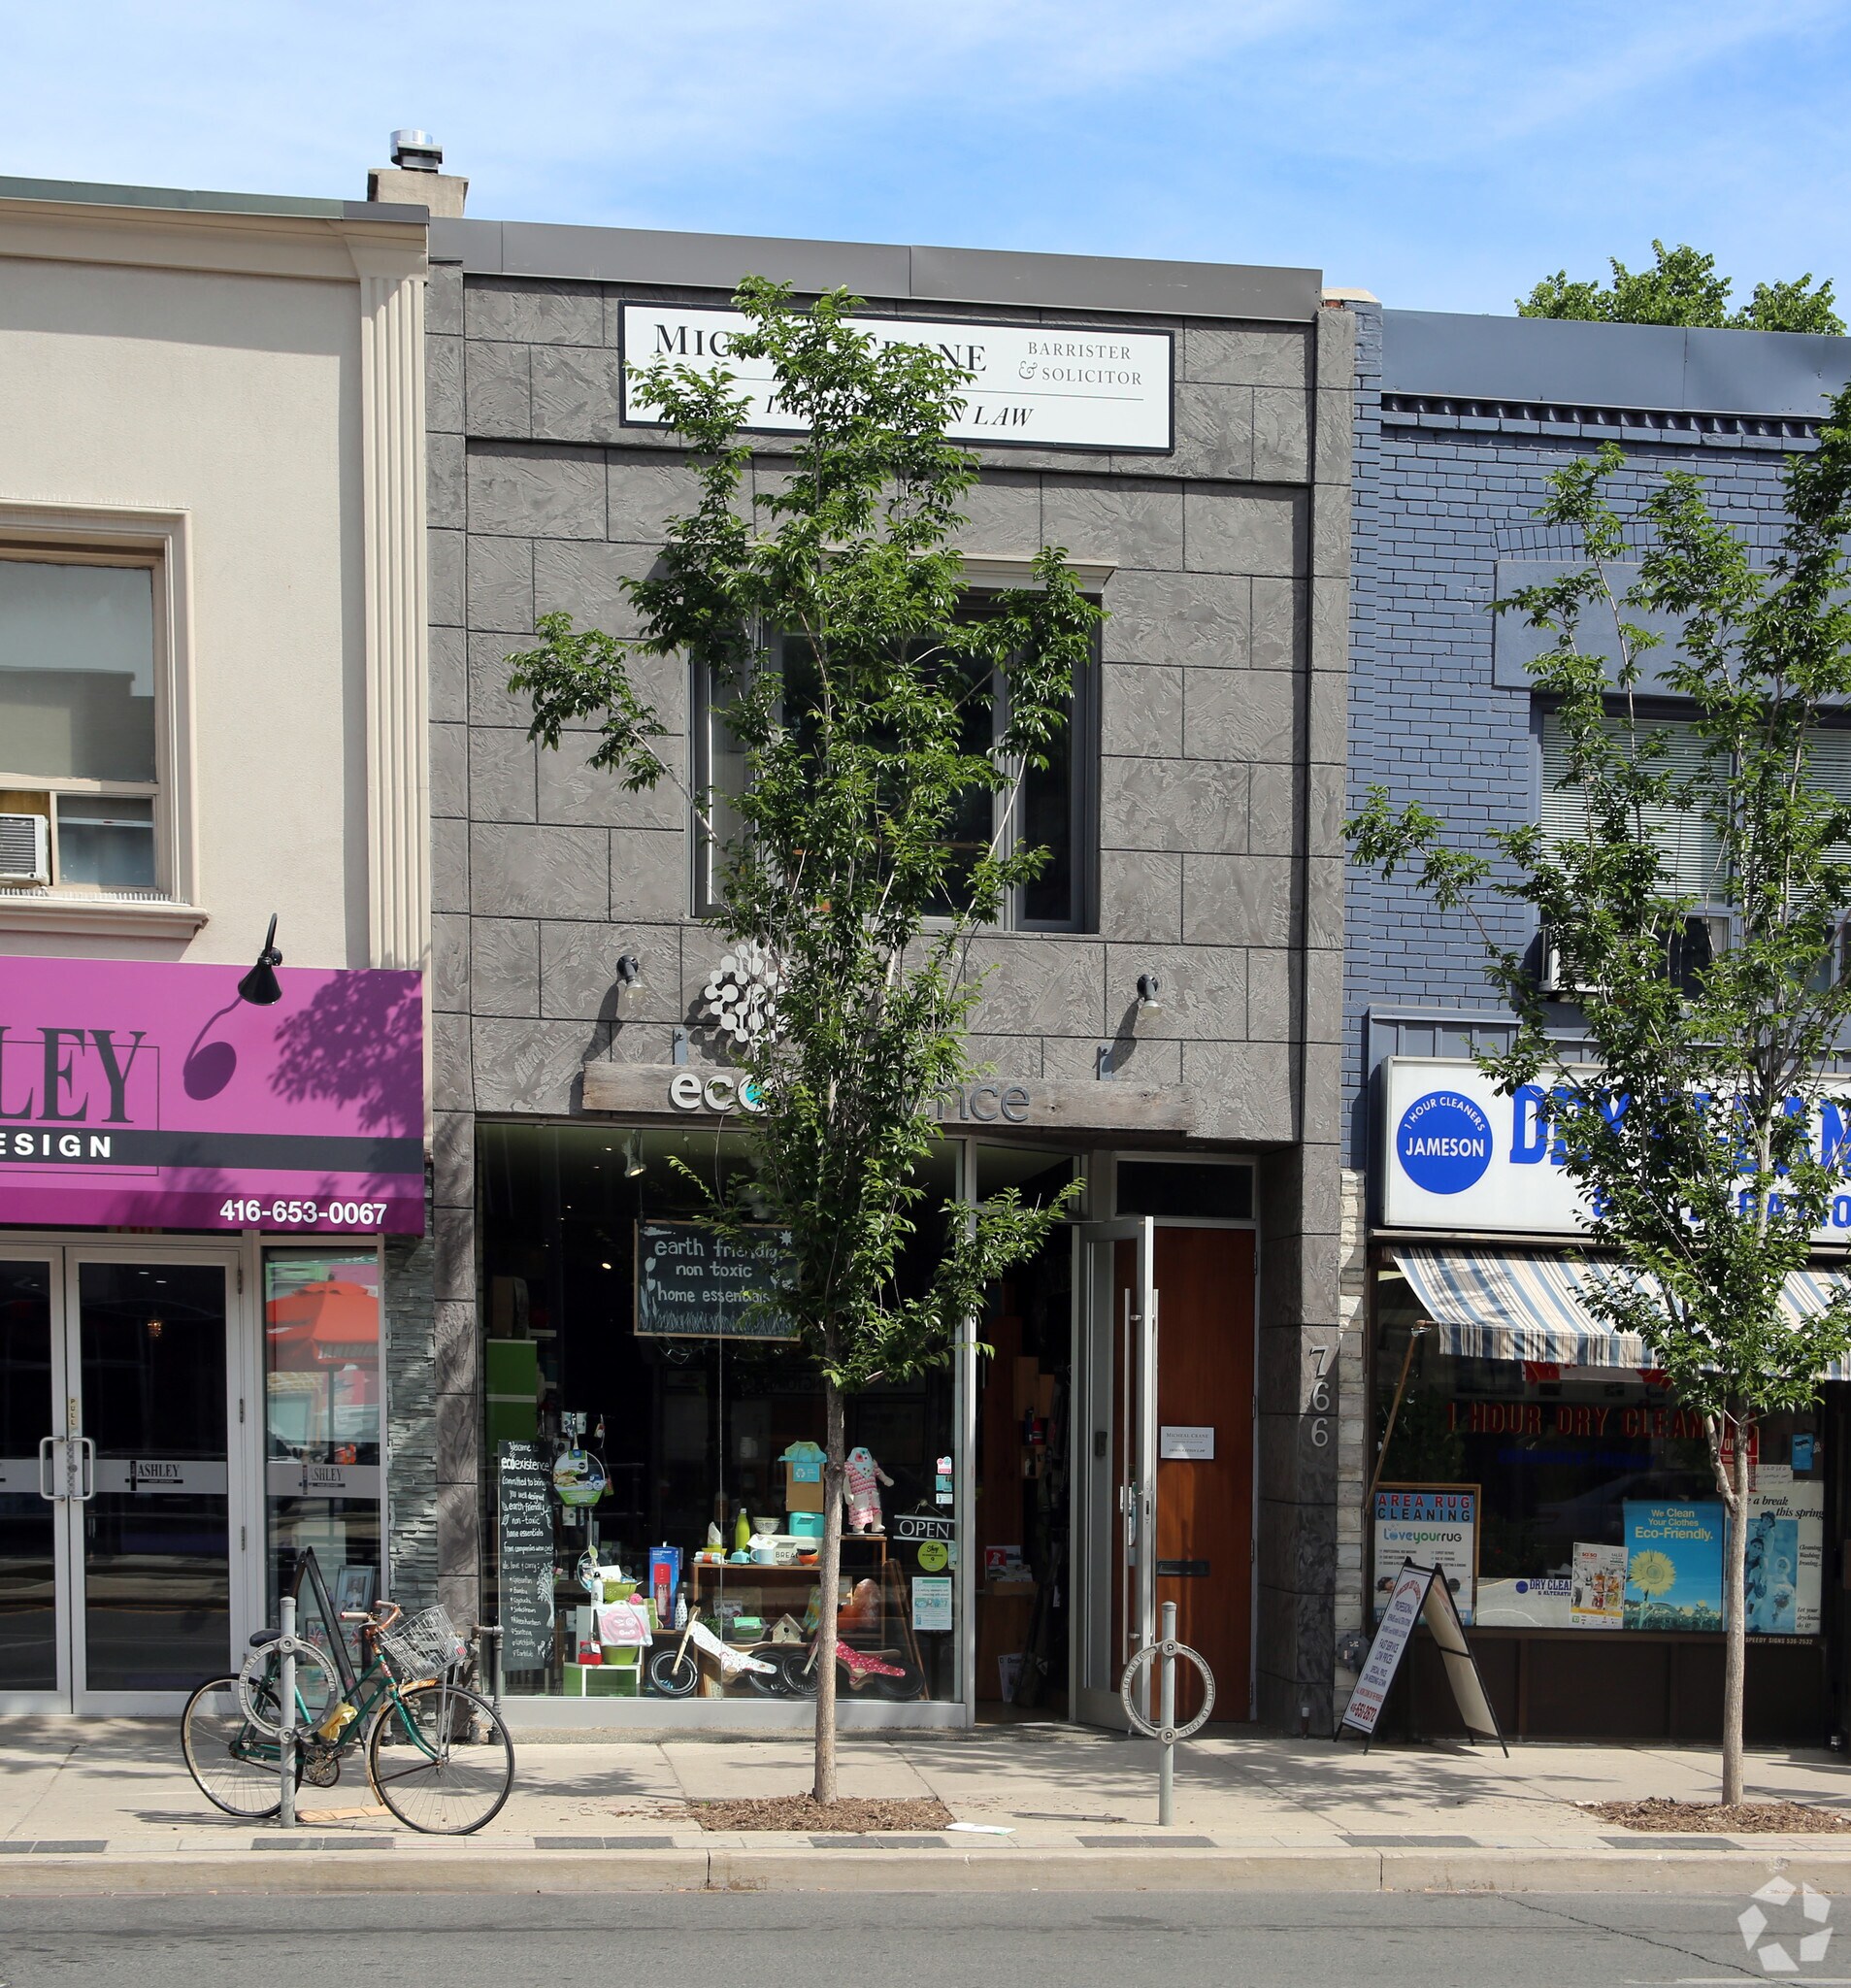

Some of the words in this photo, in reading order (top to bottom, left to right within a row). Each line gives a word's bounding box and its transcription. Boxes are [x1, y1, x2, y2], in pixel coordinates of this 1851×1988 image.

[1028, 341, 1132, 360] BARRISTER
[1018, 359, 1039, 380] &
[1041, 367, 1142, 385] SOLICITOR
[972, 405, 1036, 427] LAW
[1408, 1098, 1438, 1123] HOUR
[1439, 1096, 1486, 1132] CLEANERS
[1405, 1137, 1485, 1158] JAMESON
[219, 1199, 387, 1225] 416-653-0067
[654, 1237, 705, 1257] earth
[676, 1264, 704, 1276] non
[710, 1261, 753, 1278] toxic
[656, 1280, 696, 1303] home
[1471, 1403, 1541, 1435] HOUR
[1557, 1406, 1608, 1437] DRY
[138, 1463, 181, 1477] ASHLEY
[1377, 1494, 1424, 1508] AREA
[1435, 1496, 1471, 1509] RUG
[1762, 1496, 1789, 1506] break
[1377, 1508, 1471, 1522] CLEANING
[1667, 1508, 1695, 1518] Clean
[1775, 1508, 1794, 1517] this
[1795, 1508, 1824, 1520] spring
[899, 1519, 950, 1540] OPEN
[1635, 1526, 1714, 1541] Eco-Friendly.
[1530, 1578, 1546, 1590] DRY
